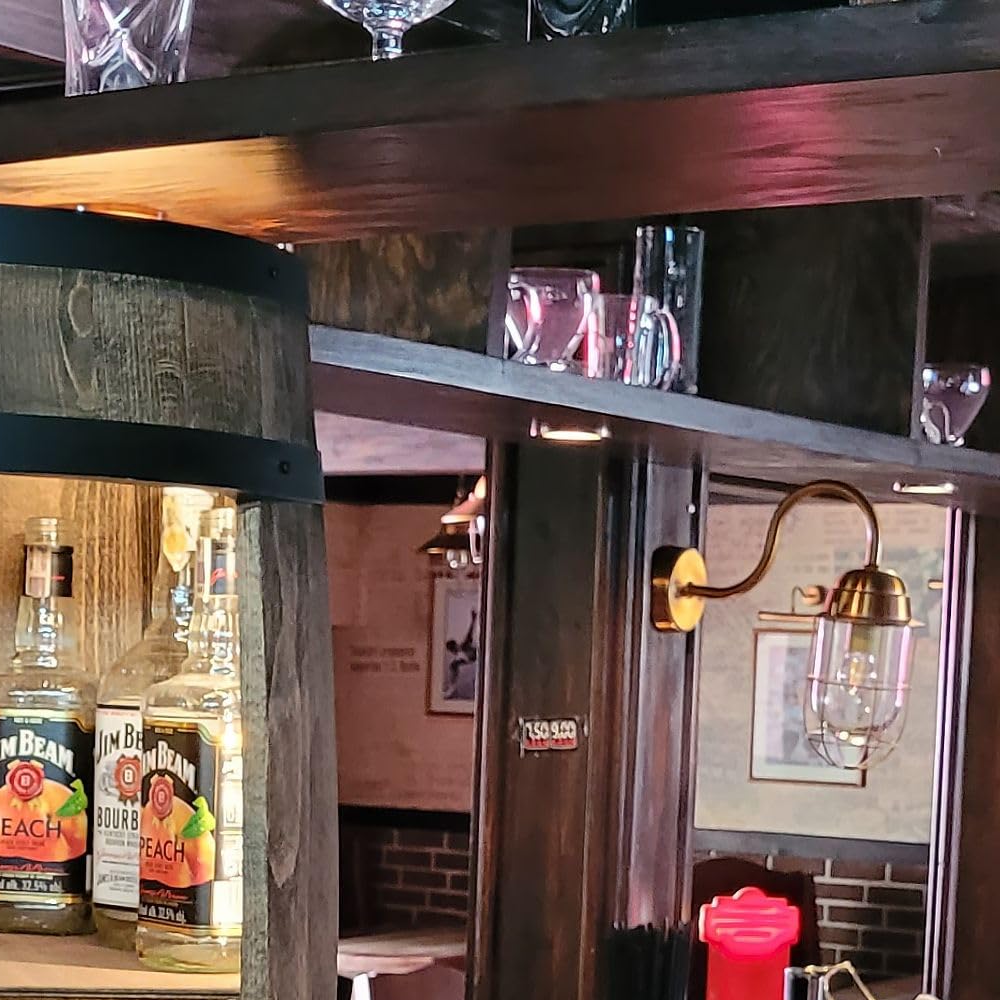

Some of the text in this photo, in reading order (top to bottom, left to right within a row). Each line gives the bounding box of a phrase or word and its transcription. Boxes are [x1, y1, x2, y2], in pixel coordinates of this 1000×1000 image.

[18, 728, 76, 777] BEAM
[97, 730, 120, 765] JIM
[158, 740, 198, 795] BEAM
[97, 806, 139, 831] BOURB
[140, 835, 185, 863] PEACH
